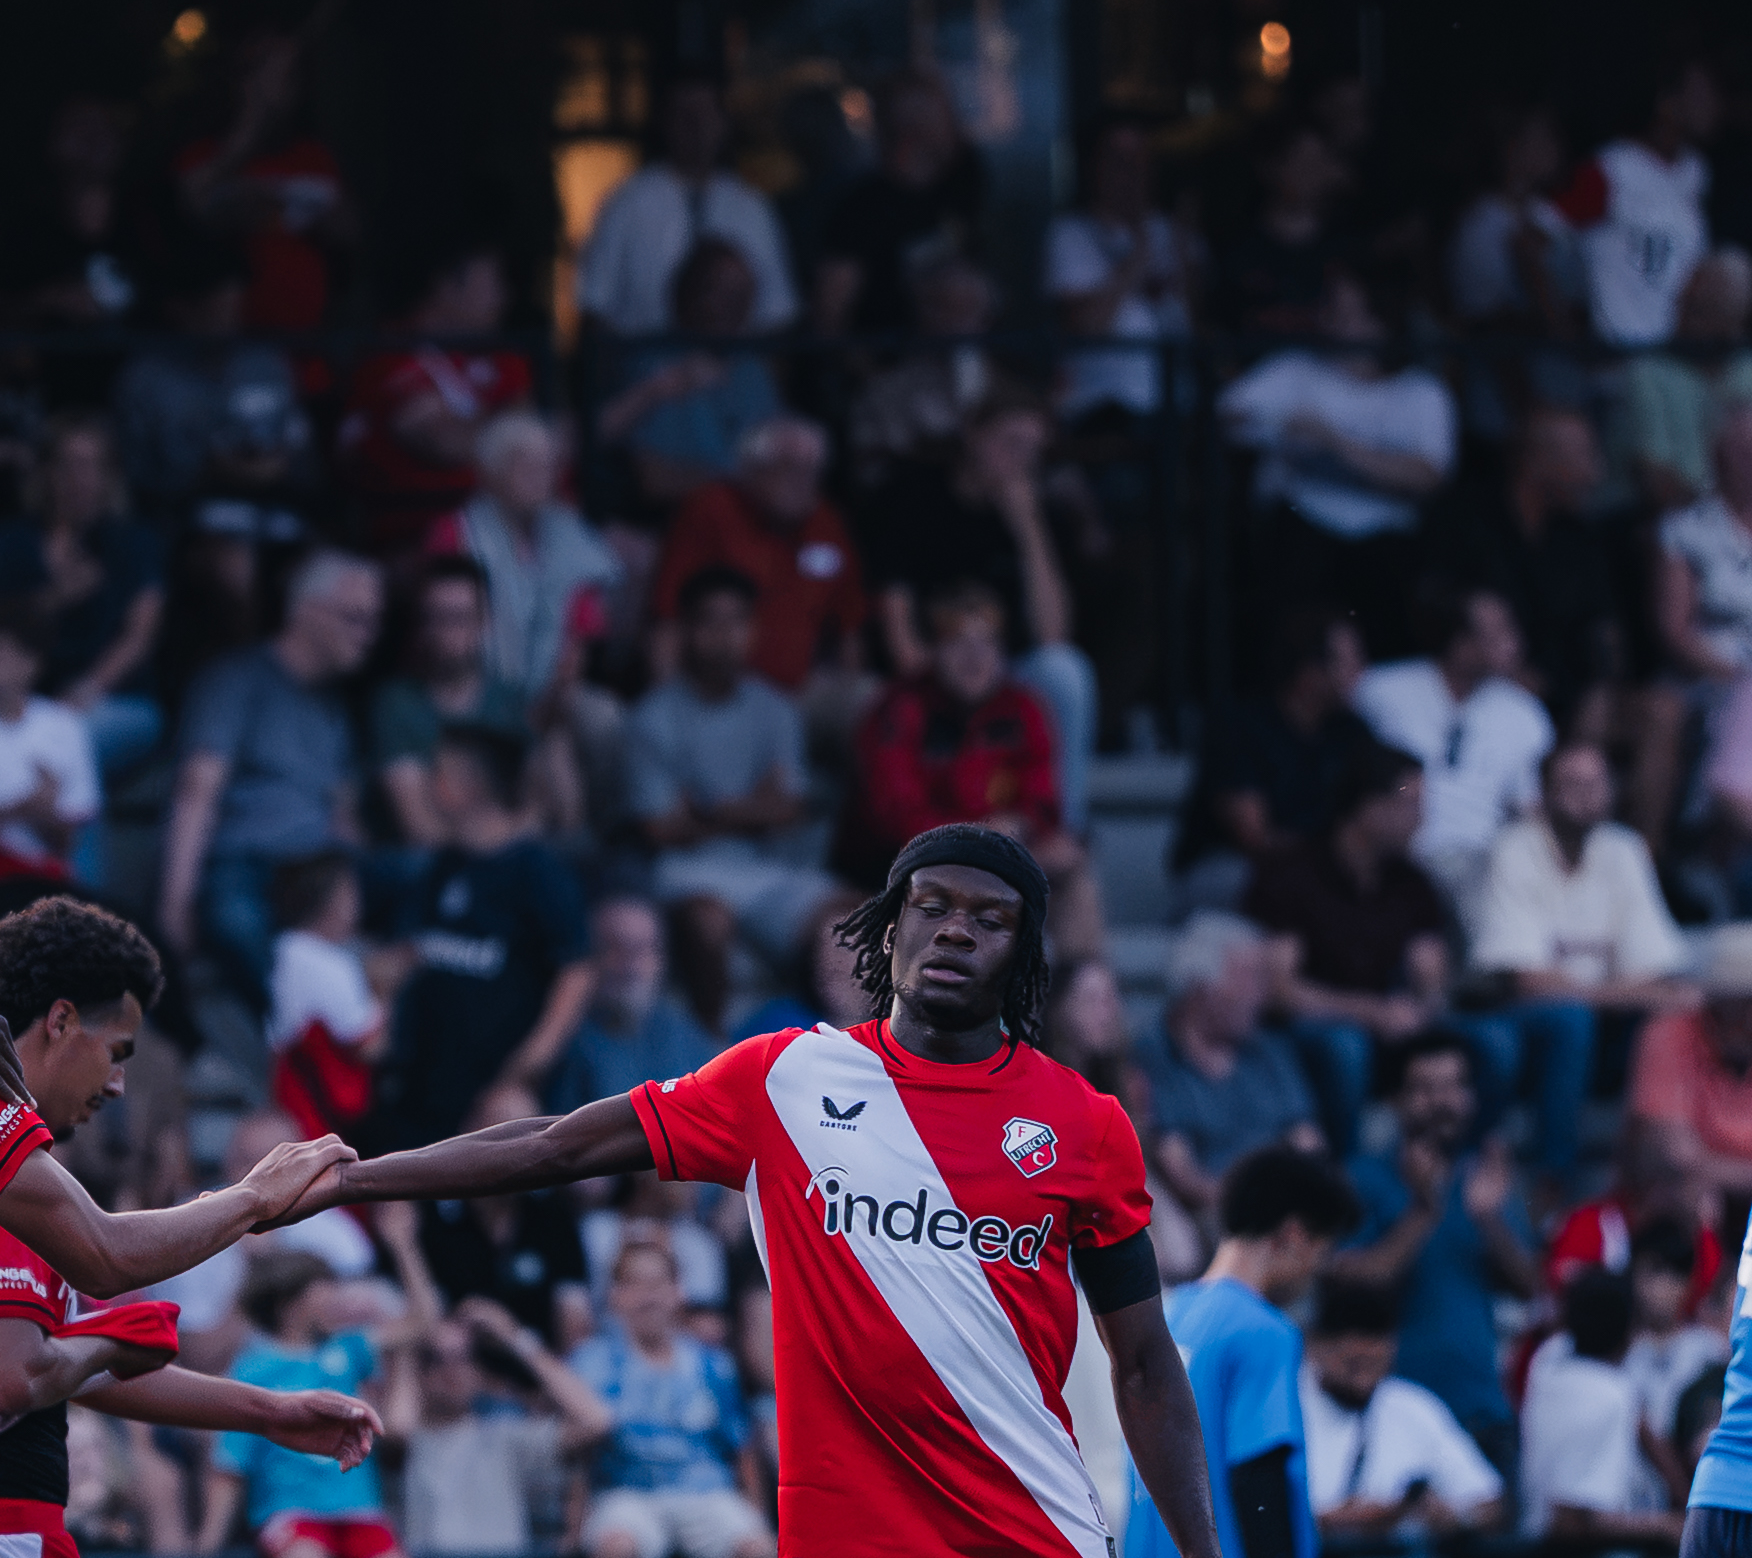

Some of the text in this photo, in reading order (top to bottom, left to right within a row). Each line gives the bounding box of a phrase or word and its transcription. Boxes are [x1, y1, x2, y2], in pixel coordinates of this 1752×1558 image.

[819, 1120, 858, 1131] CASTORE
[1017, 1126, 1026, 1137] F
[1010, 1131, 1052, 1161] UTRECHT
[1032, 1151, 1045, 1166] C
[806, 1166, 1054, 1270] indeed
